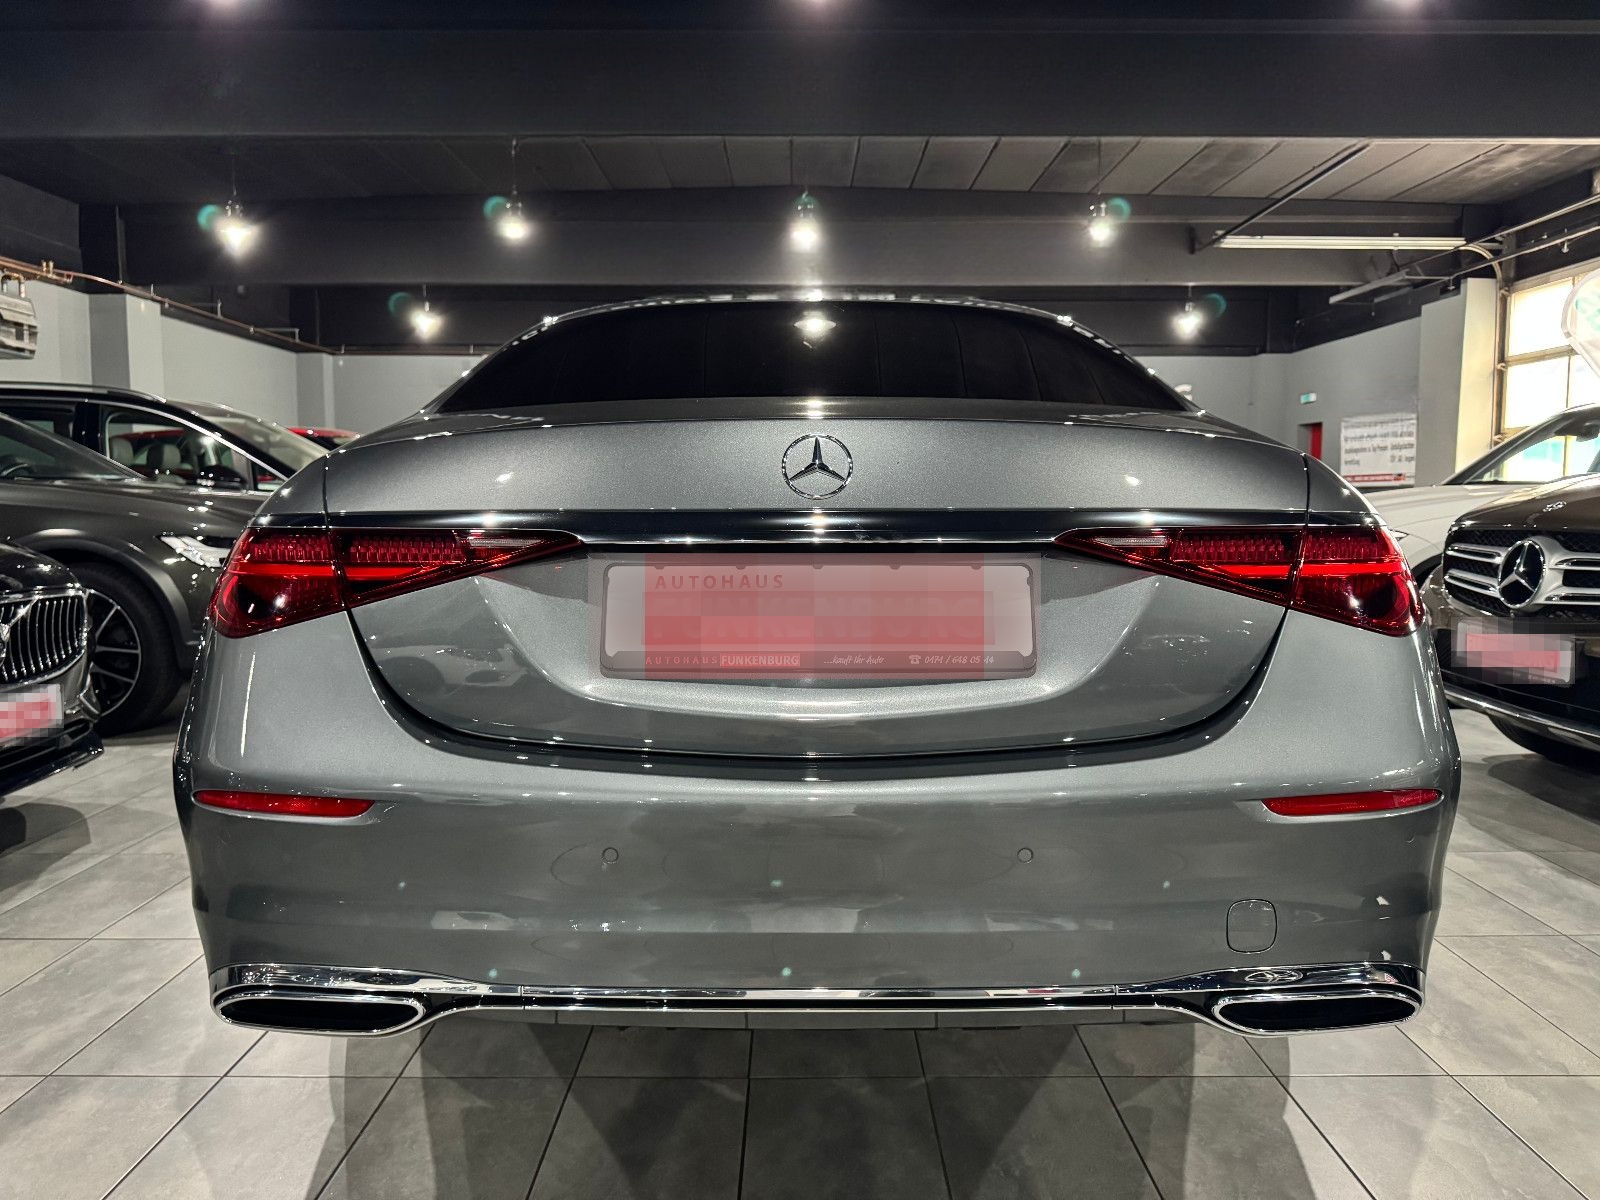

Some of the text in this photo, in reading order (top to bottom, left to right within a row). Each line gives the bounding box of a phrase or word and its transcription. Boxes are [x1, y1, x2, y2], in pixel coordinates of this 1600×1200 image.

[654, 574, 784, 589] AUTOHAUS
[651, 596, 984, 639] FUNKENBURG
[645, 655, 799, 666] AUTOHAUS FUNKENBURG
[866, 655, 884, 664] Auto
[952, 655, 968, 664] 648
[970, 655, 981, 664] 05
